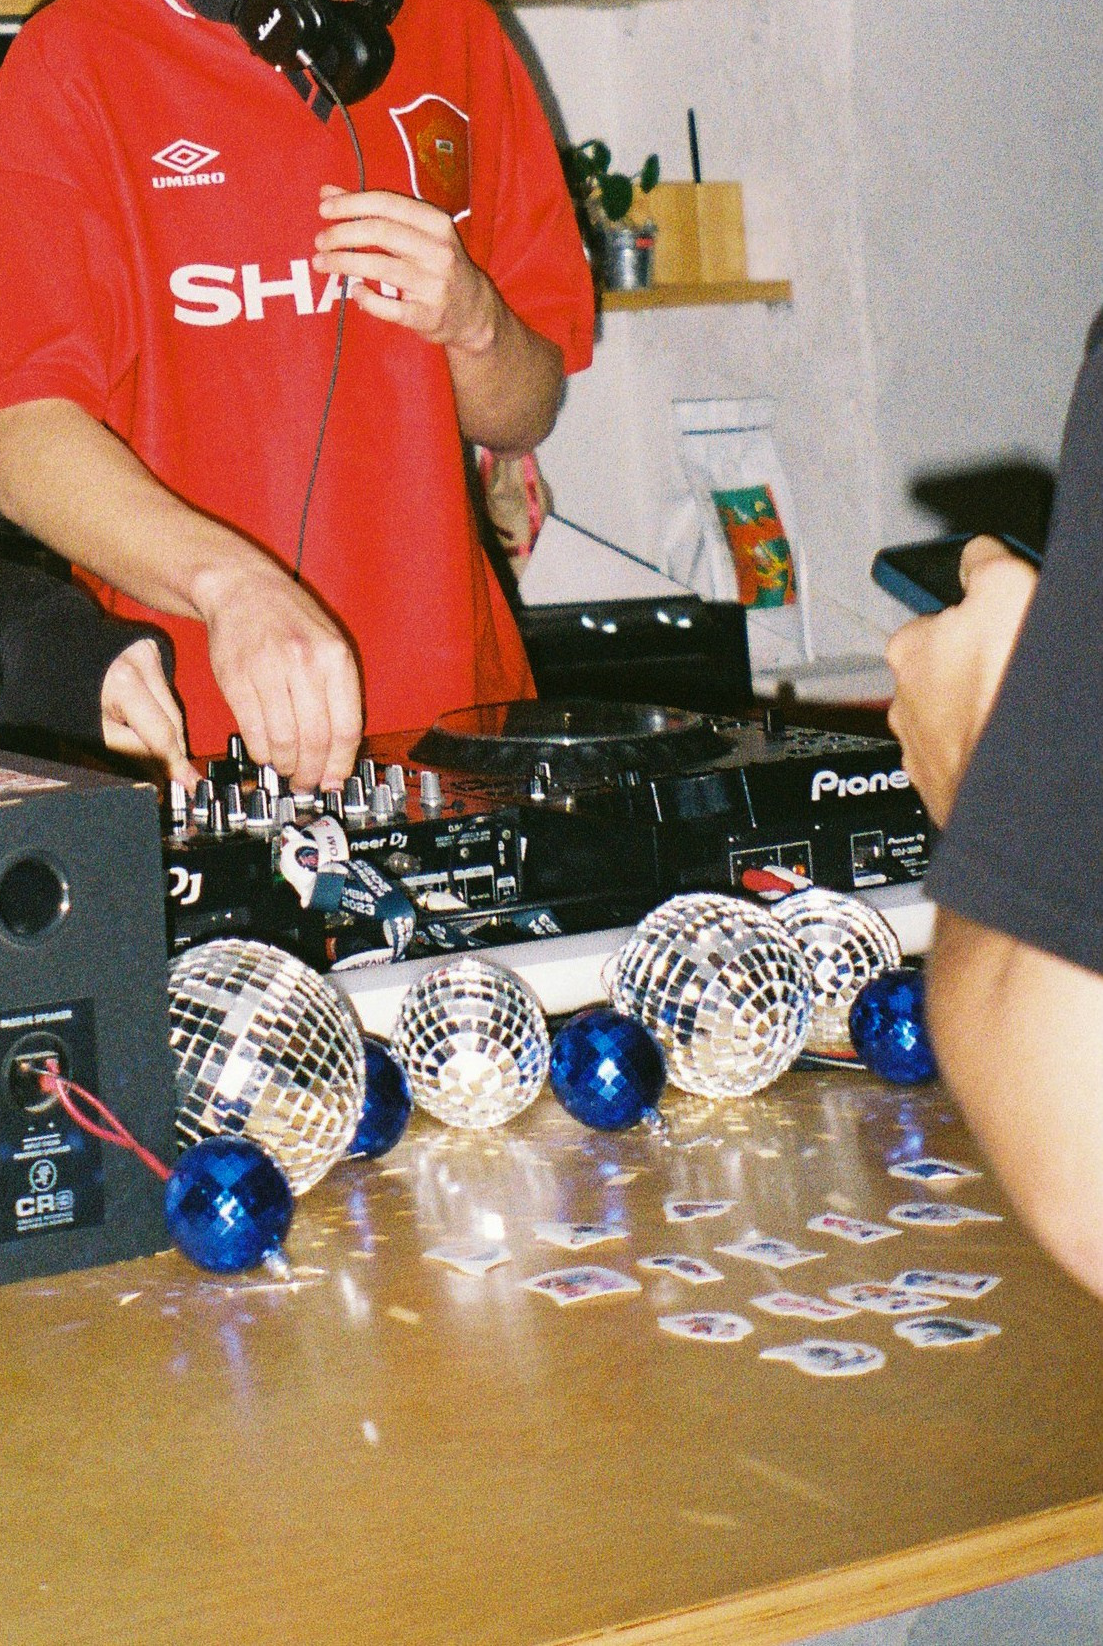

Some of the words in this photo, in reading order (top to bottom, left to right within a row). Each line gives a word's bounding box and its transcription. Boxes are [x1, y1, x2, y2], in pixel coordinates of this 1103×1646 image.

[151, 170, 226, 190] UMBRO
[168, 257, 402, 328] SHA
[810, 769, 911, 801] Pione
[349, 837, 387, 852] neer
[341, 895, 376, 916] 2023
